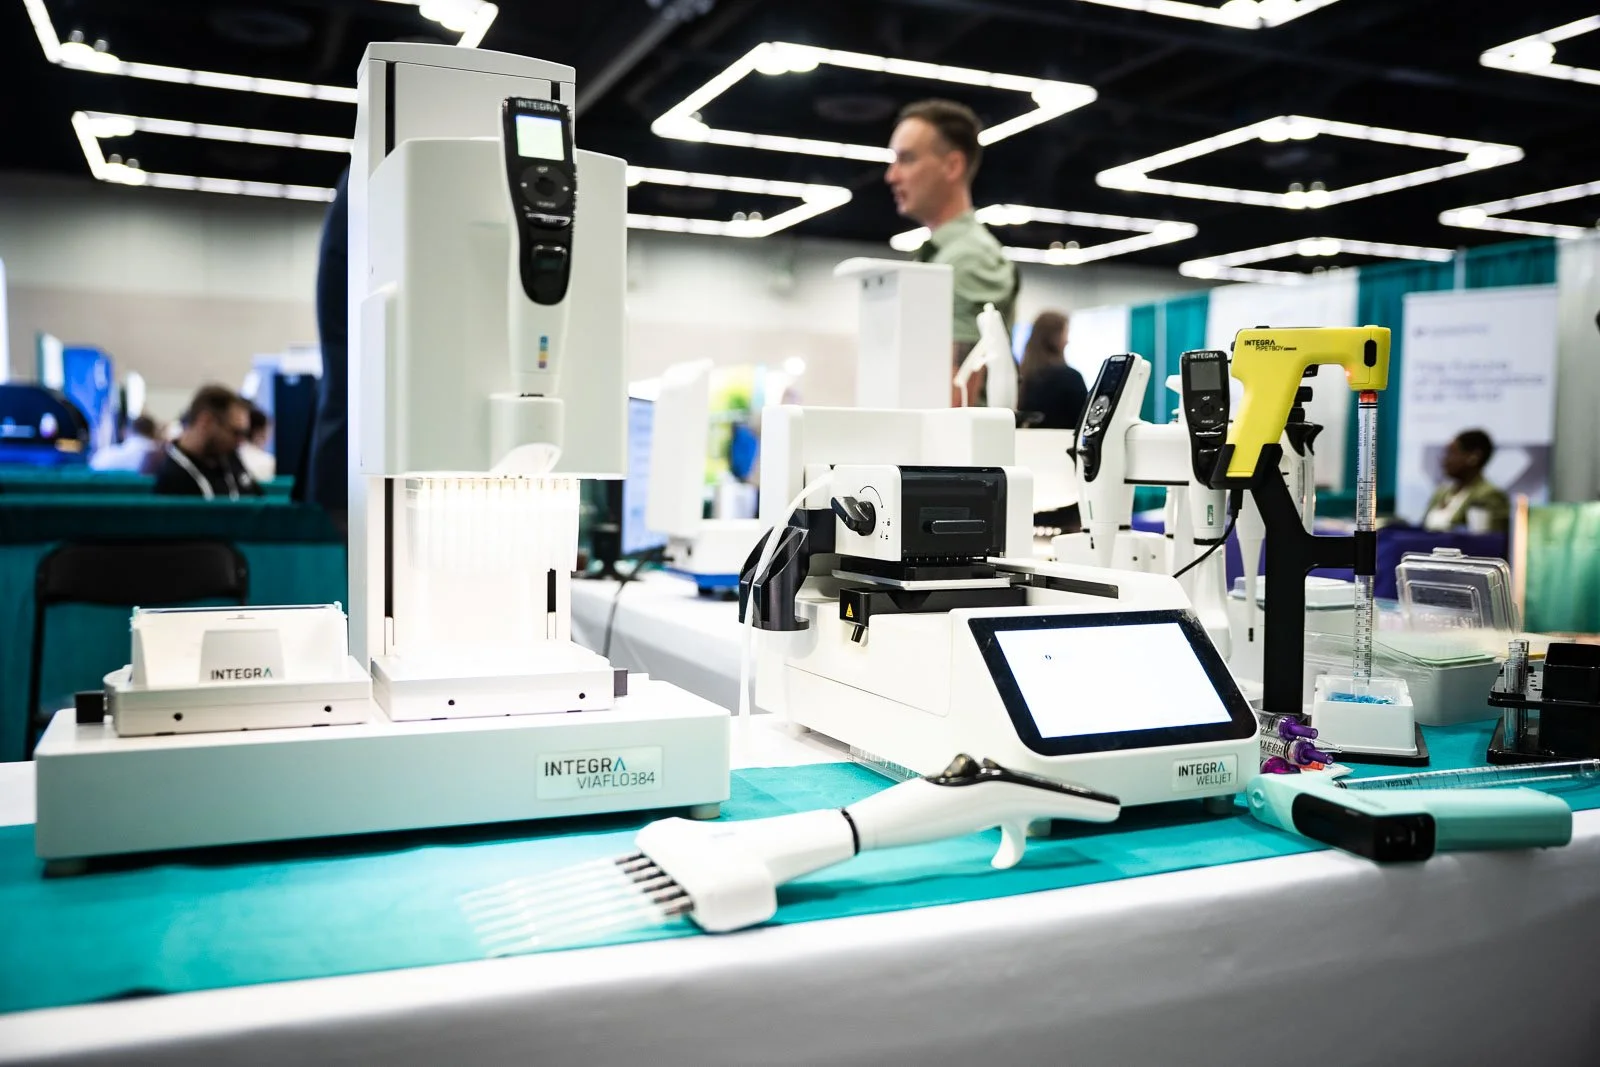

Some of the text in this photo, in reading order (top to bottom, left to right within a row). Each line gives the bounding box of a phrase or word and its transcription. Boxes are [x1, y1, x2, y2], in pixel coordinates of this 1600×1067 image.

[517, 99, 561, 112] INTEGRA
[211, 667, 273, 680] INTEGRA
[544, 756, 627, 777] INTEGRA
[1178, 761, 1225, 777] INTEGRA
[1196, 772, 1232, 786] WELLJET
